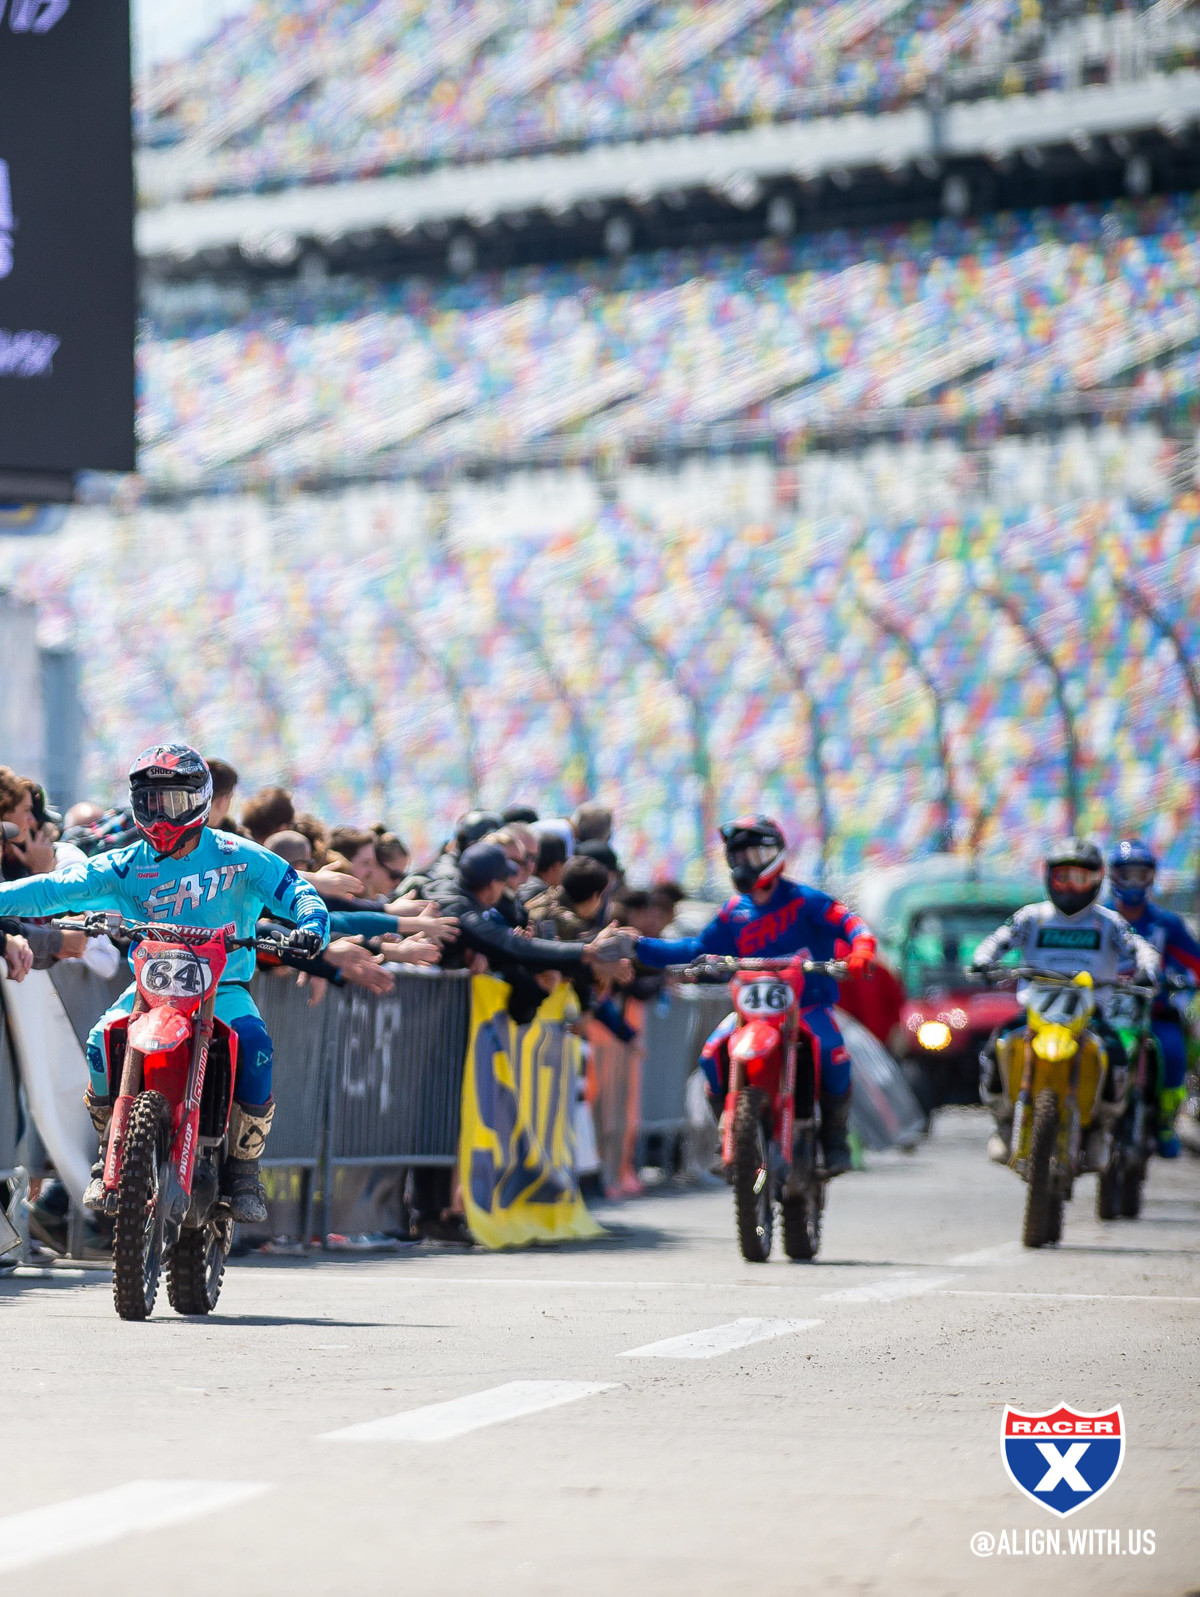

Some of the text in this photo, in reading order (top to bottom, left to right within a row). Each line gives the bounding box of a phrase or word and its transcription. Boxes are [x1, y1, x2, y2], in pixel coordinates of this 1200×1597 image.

[1041, 929, 1099, 948] THOR
[145, 960, 201, 993] 64
[744, 984, 788, 1010] 46
[1036, 985, 1081, 1014] 71
[109, 1126, 121, 1179] DLOP
[179, 1122, 193, 1176] DUNLOP
